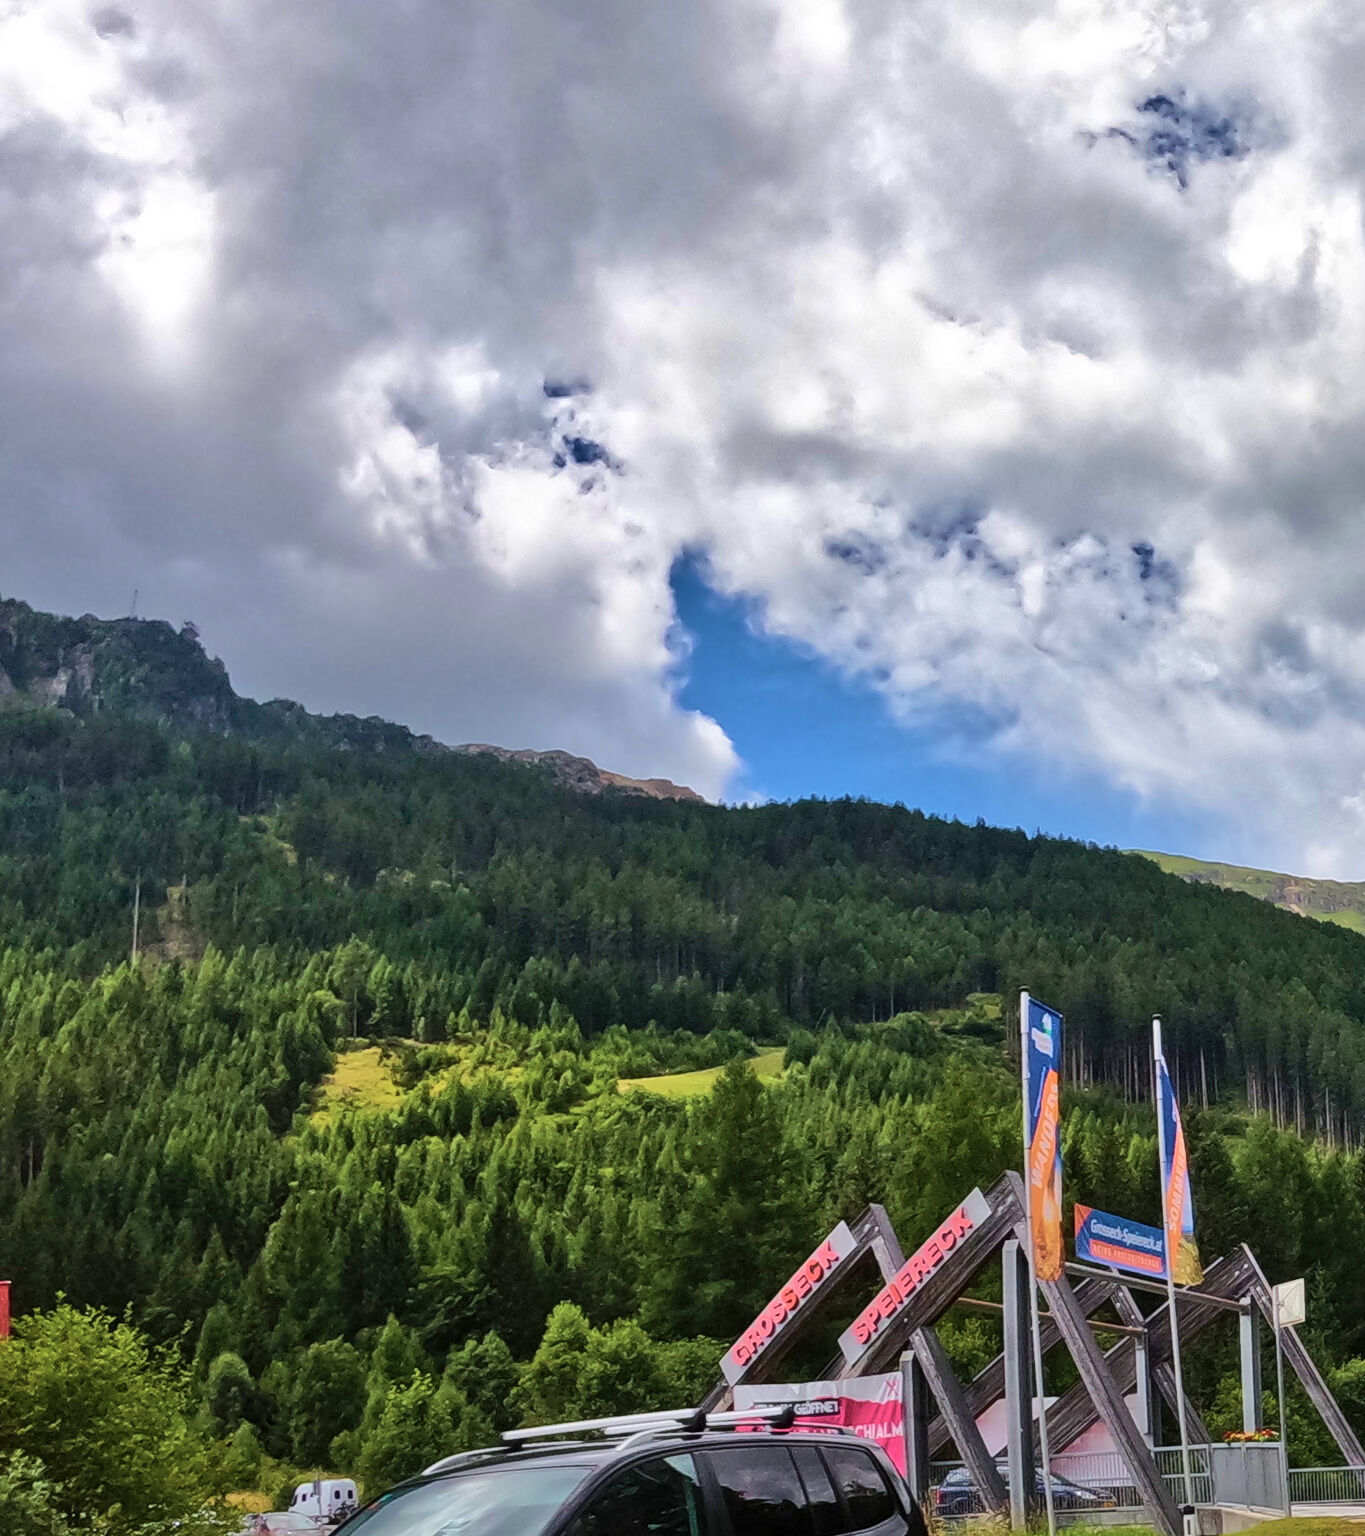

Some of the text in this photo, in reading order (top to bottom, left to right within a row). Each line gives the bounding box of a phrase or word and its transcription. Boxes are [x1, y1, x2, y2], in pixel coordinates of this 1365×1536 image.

[732, 1240, 839, 1367] GROSSECK
[852, 1207, 974, 1344] SPEIERECK
[855, 1421, 903, 1440] CHIALM
